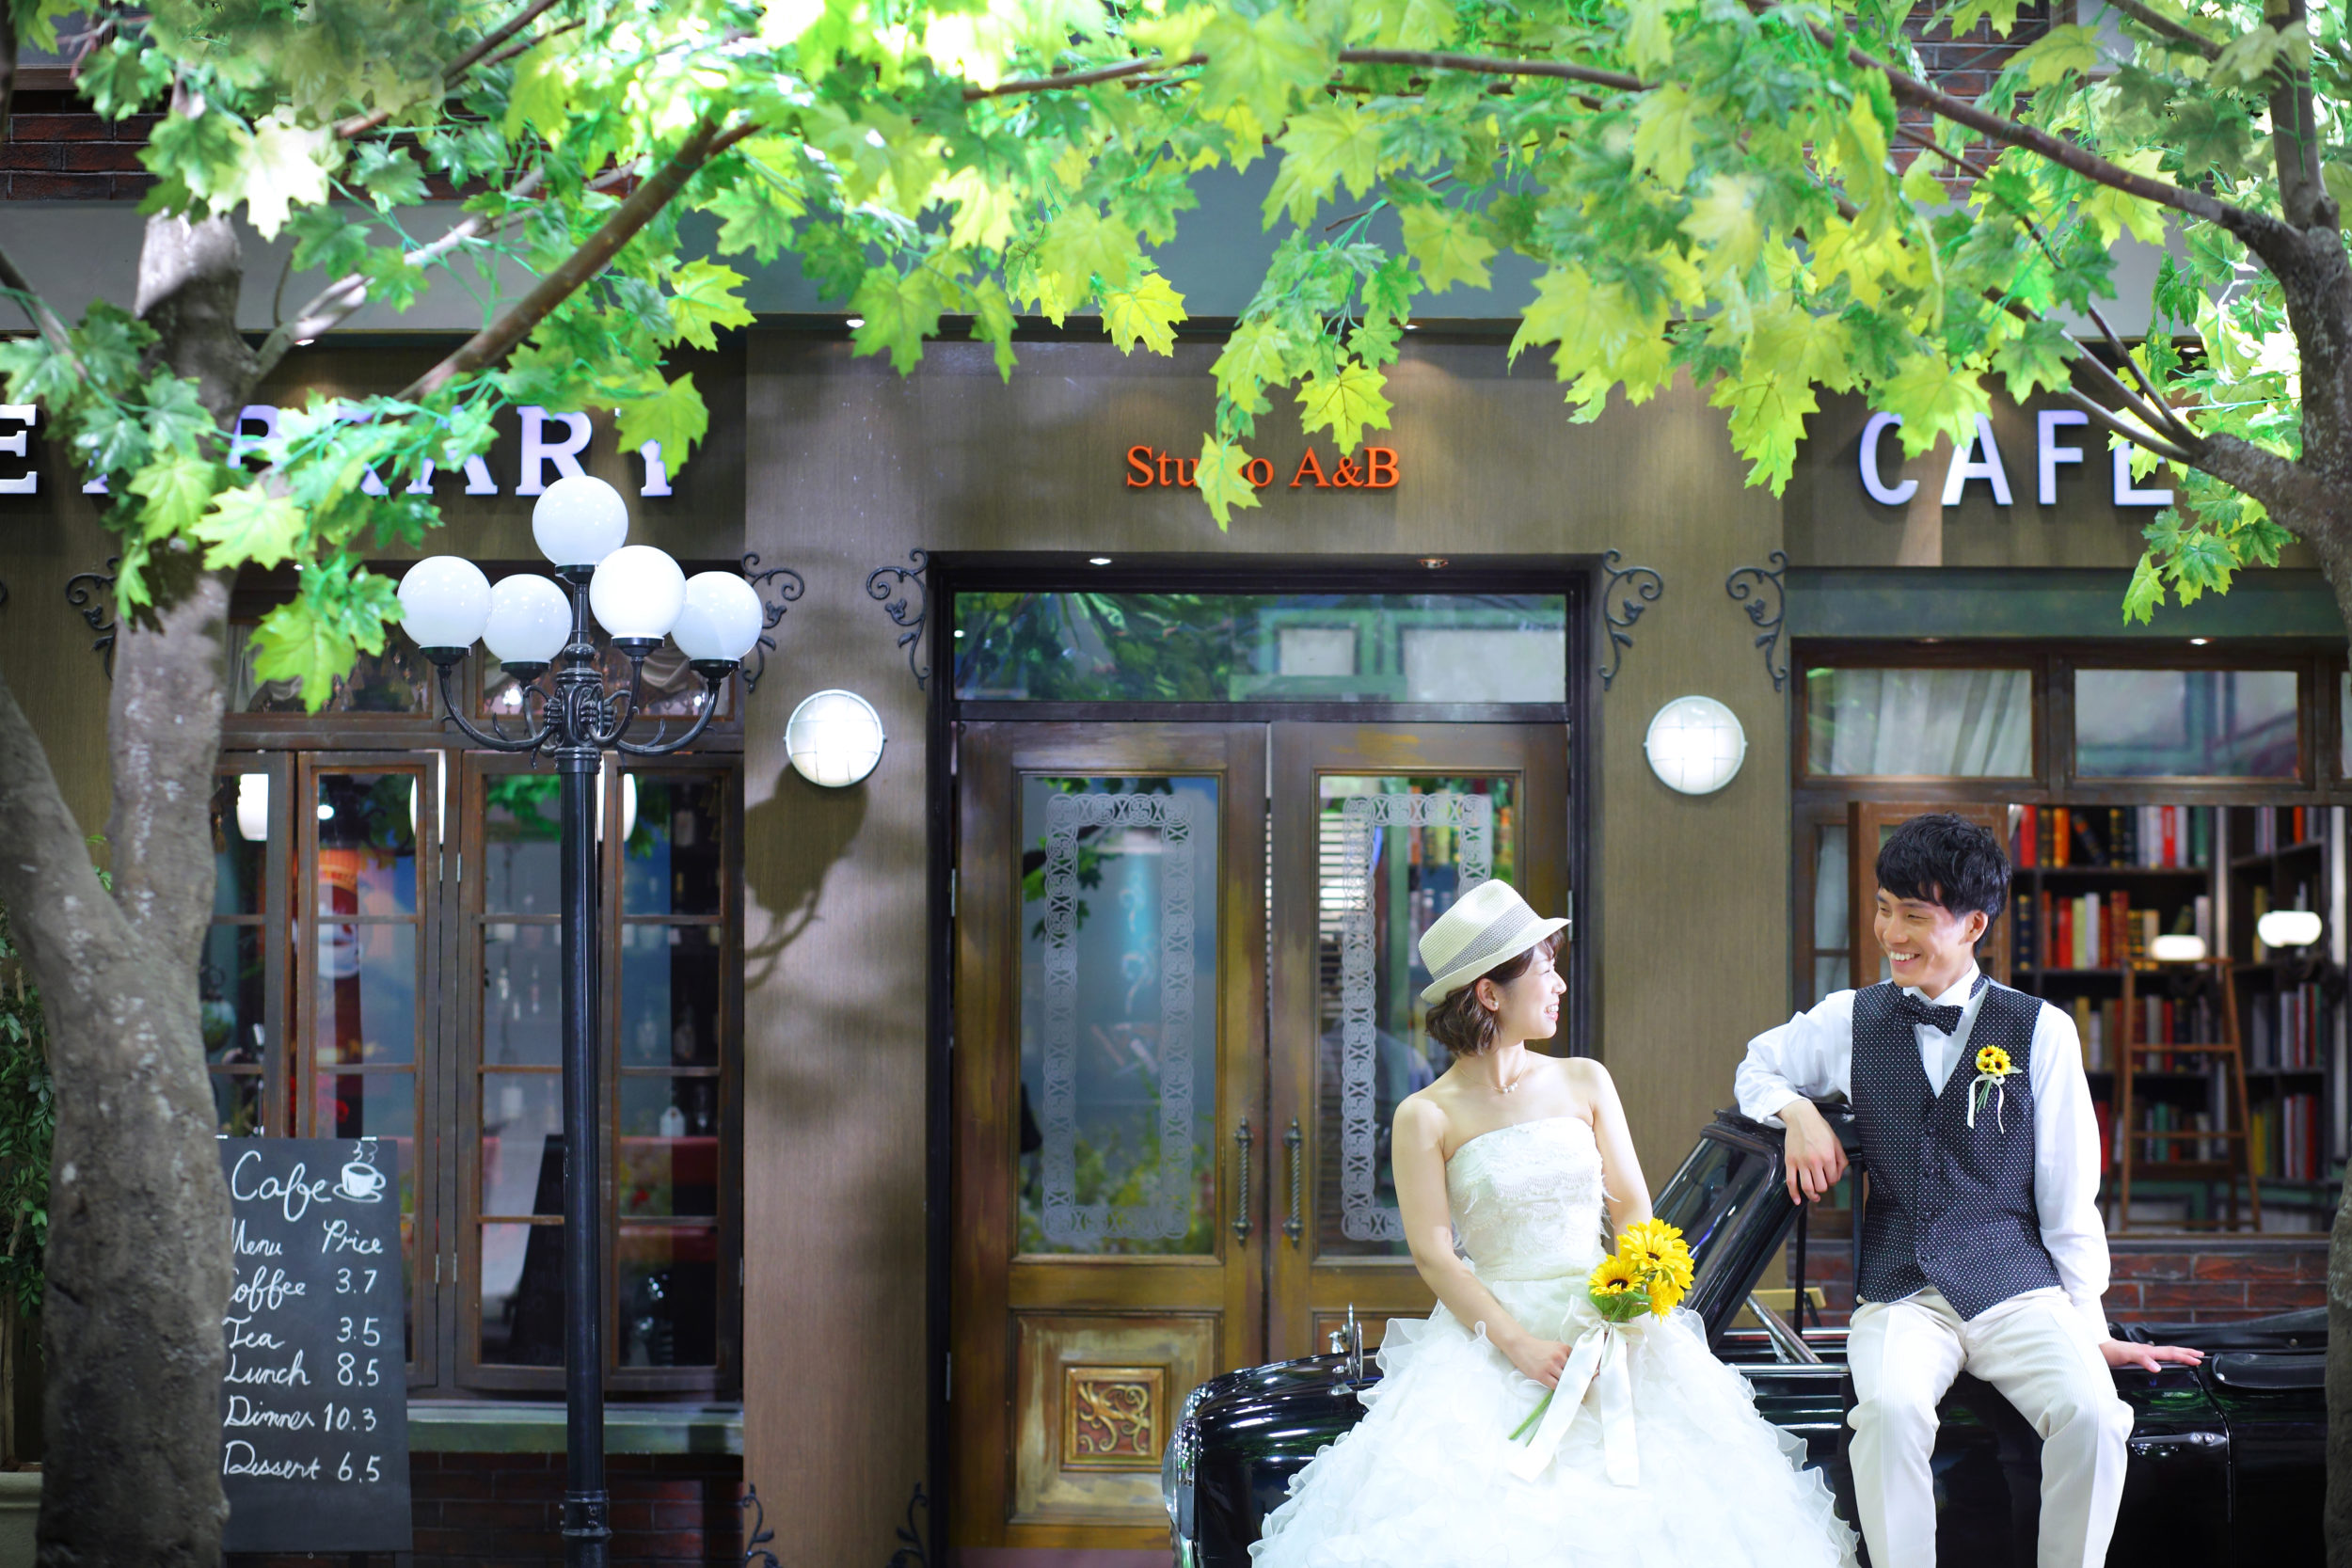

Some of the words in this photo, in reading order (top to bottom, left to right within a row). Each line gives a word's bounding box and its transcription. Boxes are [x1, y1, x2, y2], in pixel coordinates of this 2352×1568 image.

[1127, 445, 1275, 488] Stuo
[1288, 446, 1401, 488] A&B
[231, 1149, 332, 1222] Cafe
[322, 1219, 383, 1254] Price
[229, 1265, 306, 1312] offee
[336, 1268, 377, 1294] 3.7
[221, 1315, 286, 1349] Tea
[337, 1317, 381, 1347] 3.5
[224, 1349, 311, 1386] Lunch
[337, 1352, 380, 1386] 8.5
[223, 1395, 315, 1431] Dinner
[325, 1402, 377, 1432] 10.3
[223, 1440, 321, 1481] Dessert
[337, 1451, 381, 1483] 6.5
